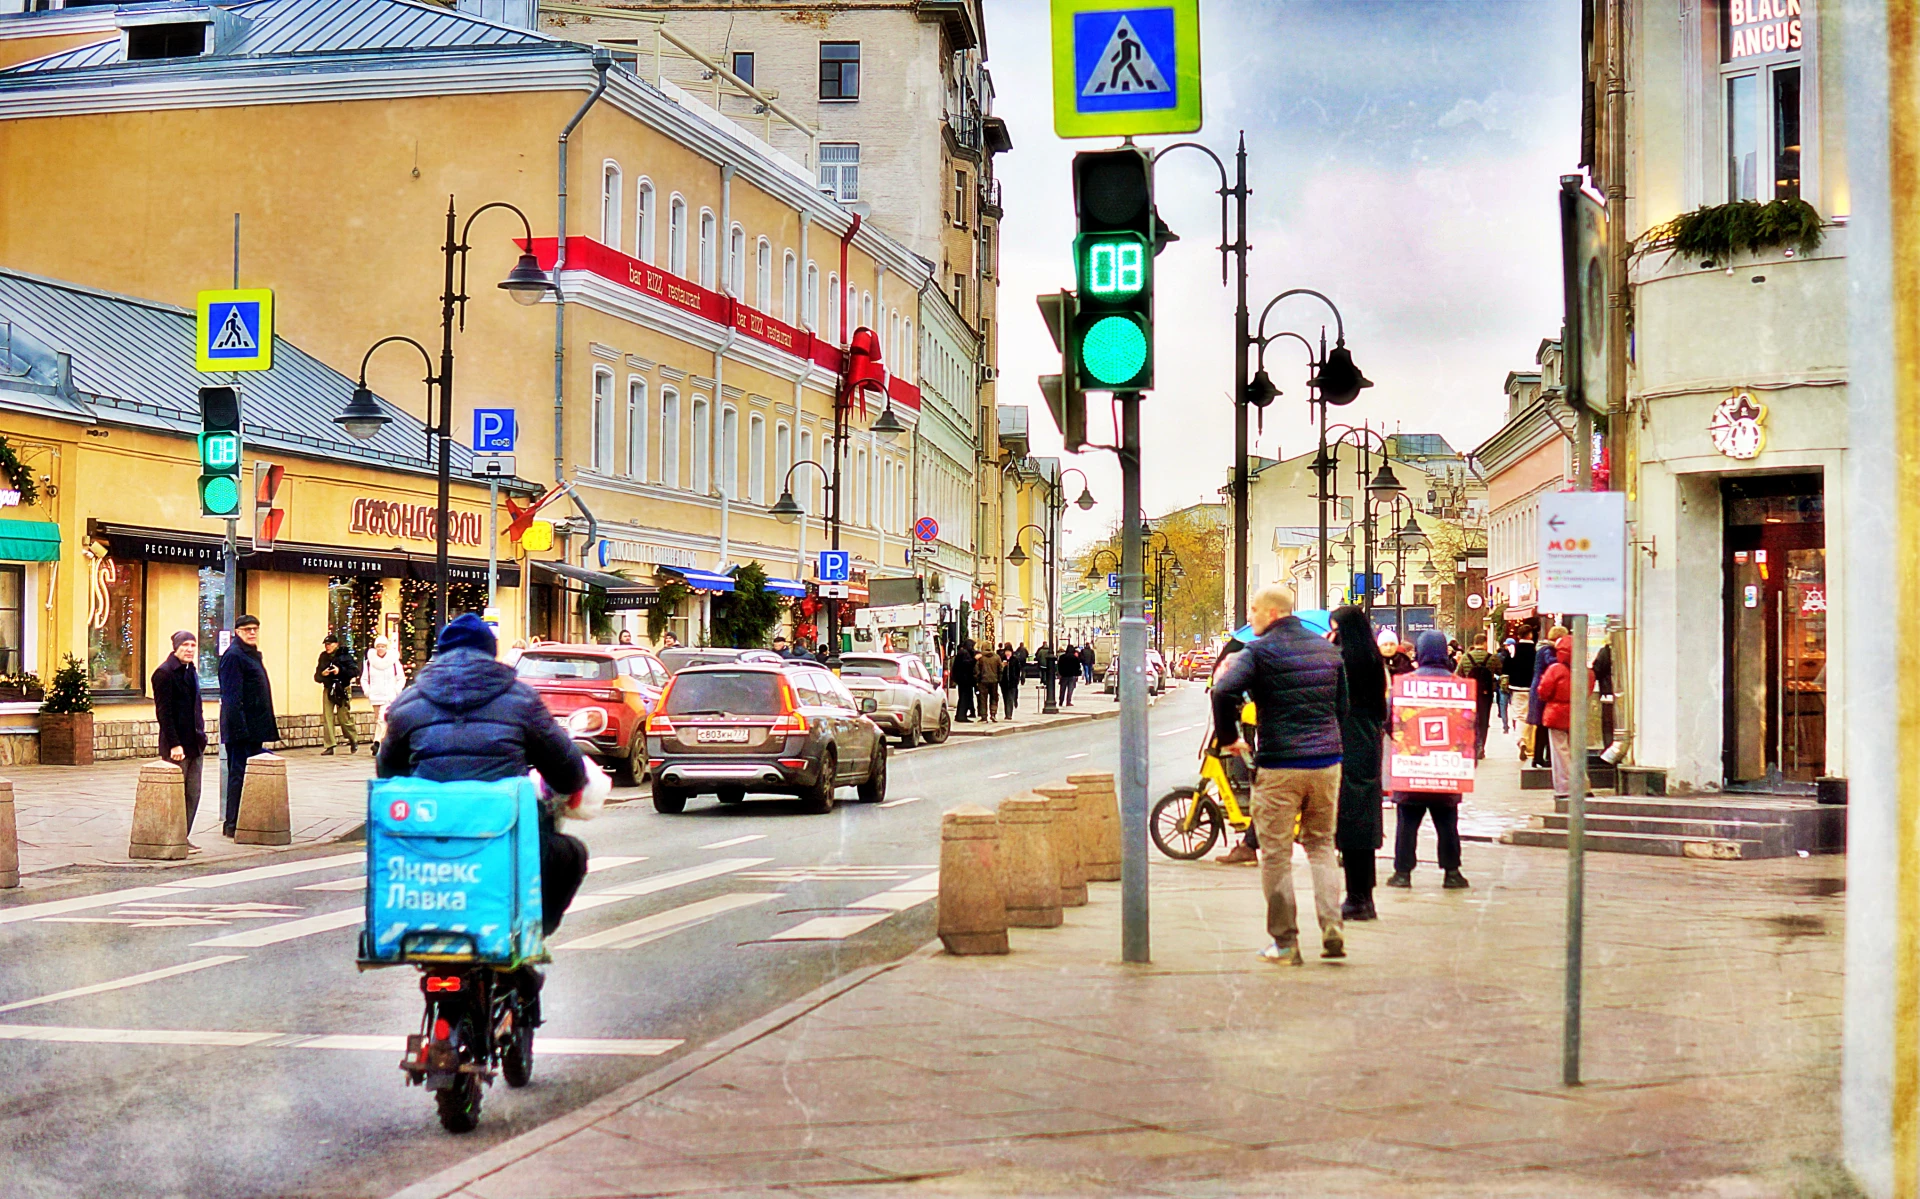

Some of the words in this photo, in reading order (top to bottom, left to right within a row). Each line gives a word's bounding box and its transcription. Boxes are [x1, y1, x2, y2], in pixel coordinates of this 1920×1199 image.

[1730, 0, 1801, 26] BLACK
[1731, 20, 1803, 58] ANGUS
[1089, 243, 1144, 292] 08
[628, 261, 642, 286] bar
[646, 270, 664, 296] RIZZ
[667, 283, 701, 310] restaurant
[736, 306, 747, 328] bar
[750, 313, 764, 337] RIZZ
[766, 325, 793, 349] restaurant
[480, 412, 503, 448] P
[208, 438, 237, 464] 08
[145, 543, 194, 558] РЕСТОРАН
[199, 549, 211, 558] ОТ
[302, 557, 343, 570] РЕСТОРАН
[347, 561, 357, 570] ОТ
[361, 562, 382, 571] ДУШИ
[448, 568, 468, 578] ТОРАН
[826, 553, 843, 578] P
[1402, 680, 1468, 699] ЦВЕТЫ
[1433, 754, 1460, 769] 150
[394, 803, 406, 818] Я
[386, 856, 482, 886] Яндекс
[385, 883, 467, 911] Лавка
